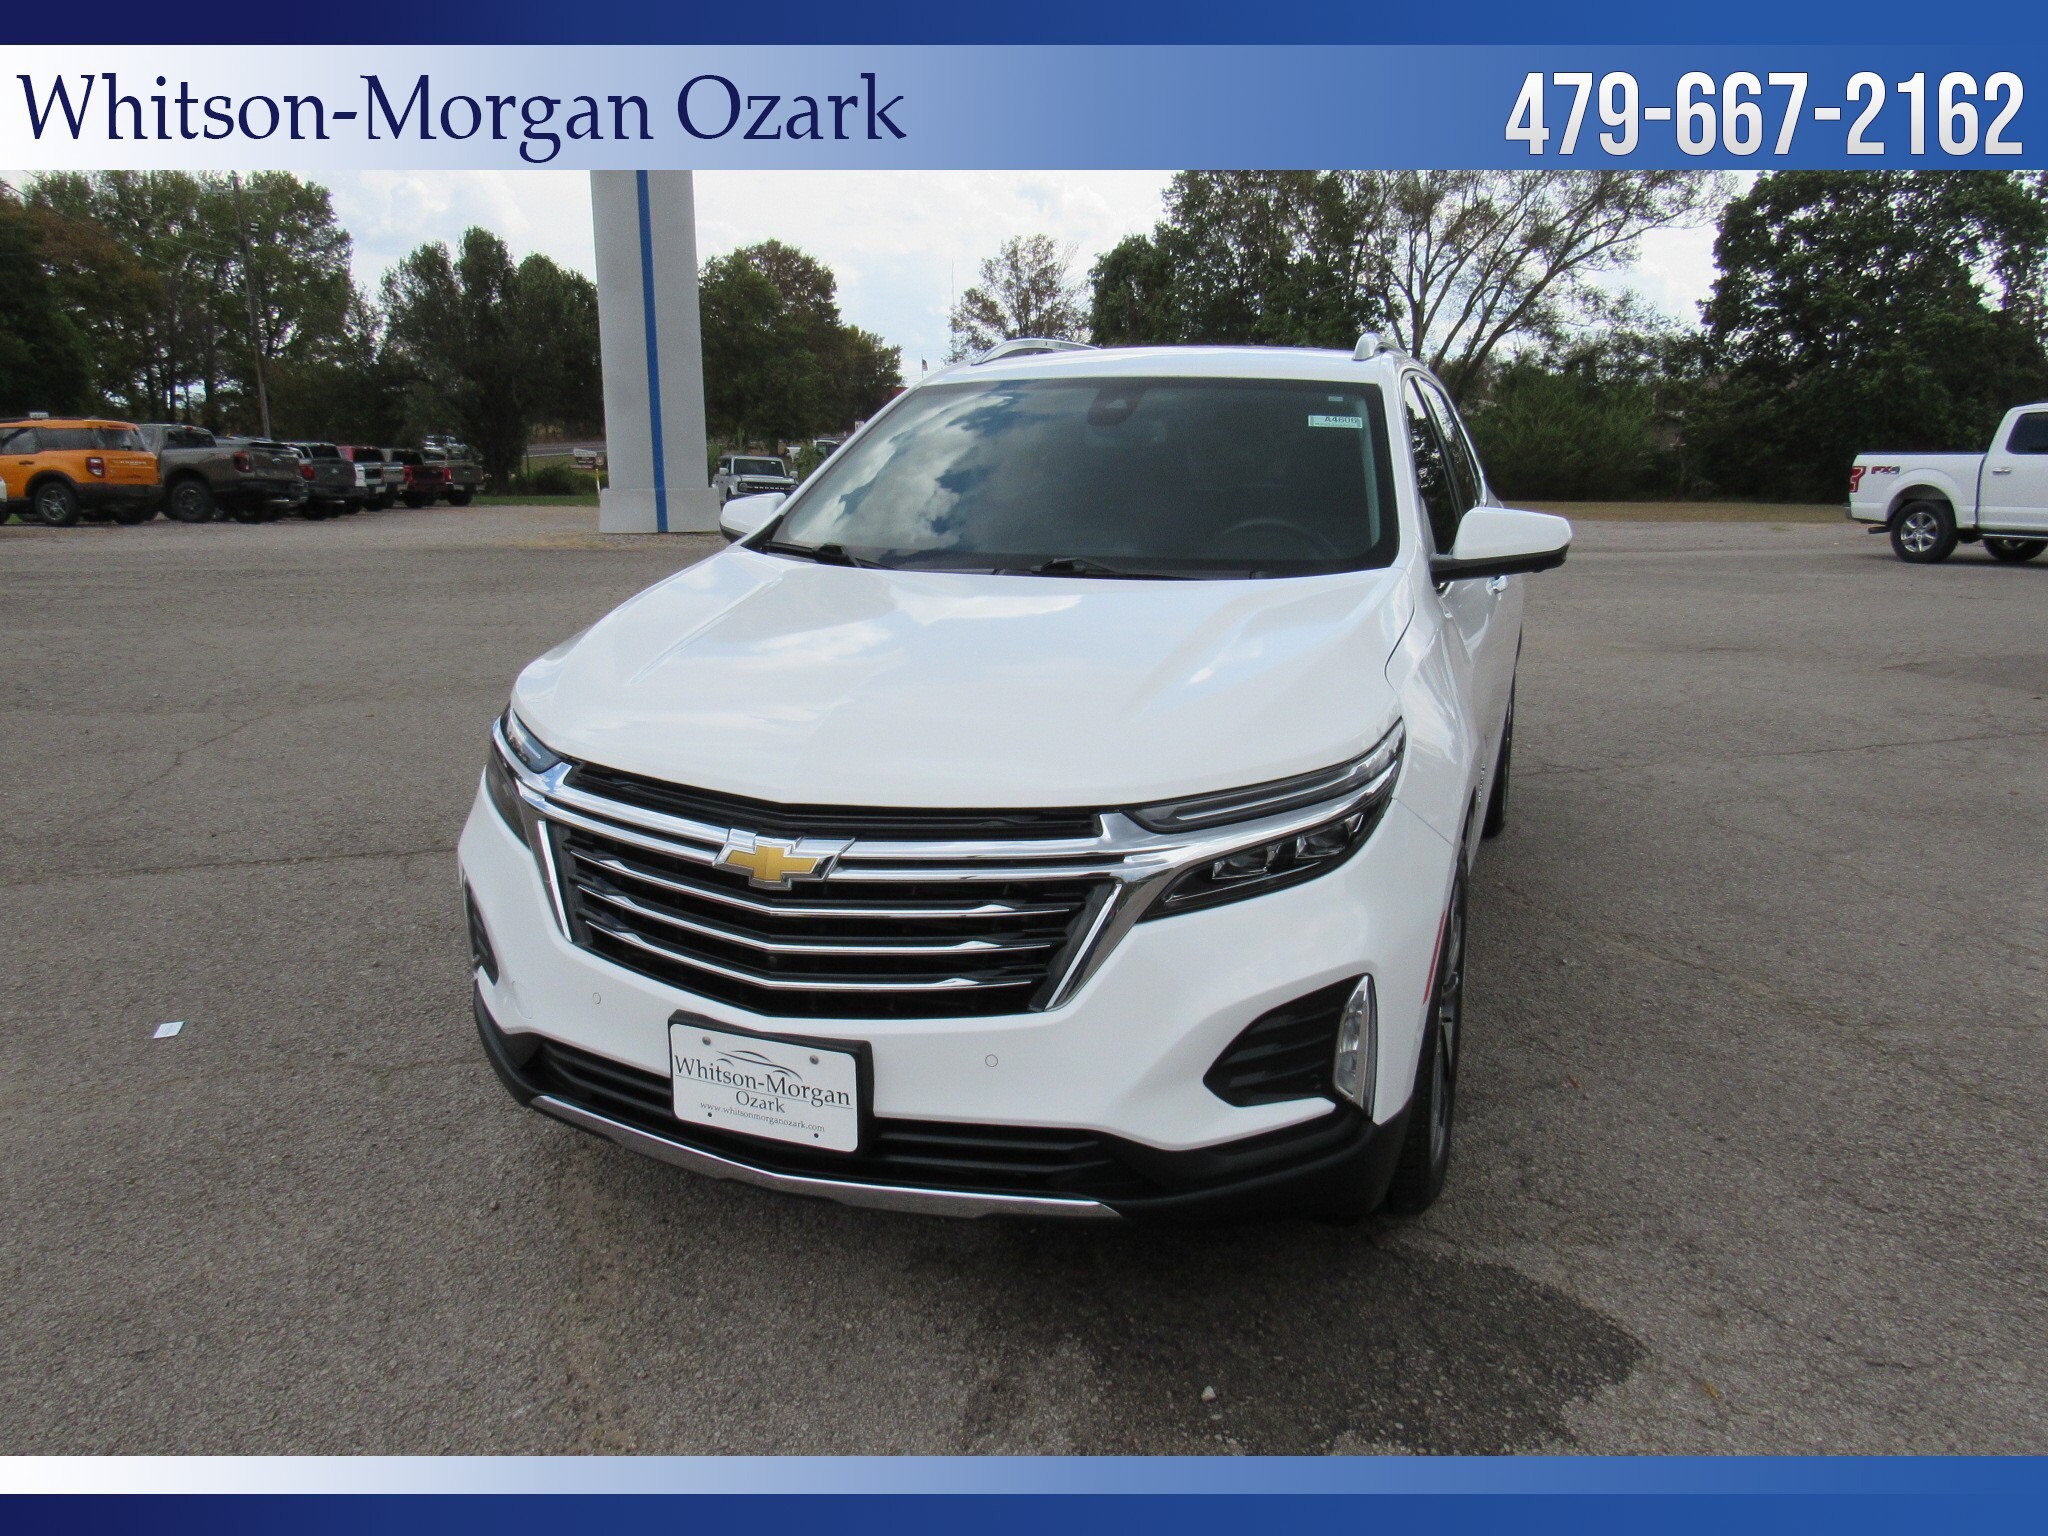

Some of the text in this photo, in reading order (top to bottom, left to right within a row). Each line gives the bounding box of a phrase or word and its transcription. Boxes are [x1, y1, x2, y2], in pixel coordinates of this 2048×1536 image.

[674, 1055, 851, 1107] Whitson-Morgan
[700, 1101, 825, 1132] www.whitsonmorganozark.com
[735, 1090, 786, 1113] Ozark
